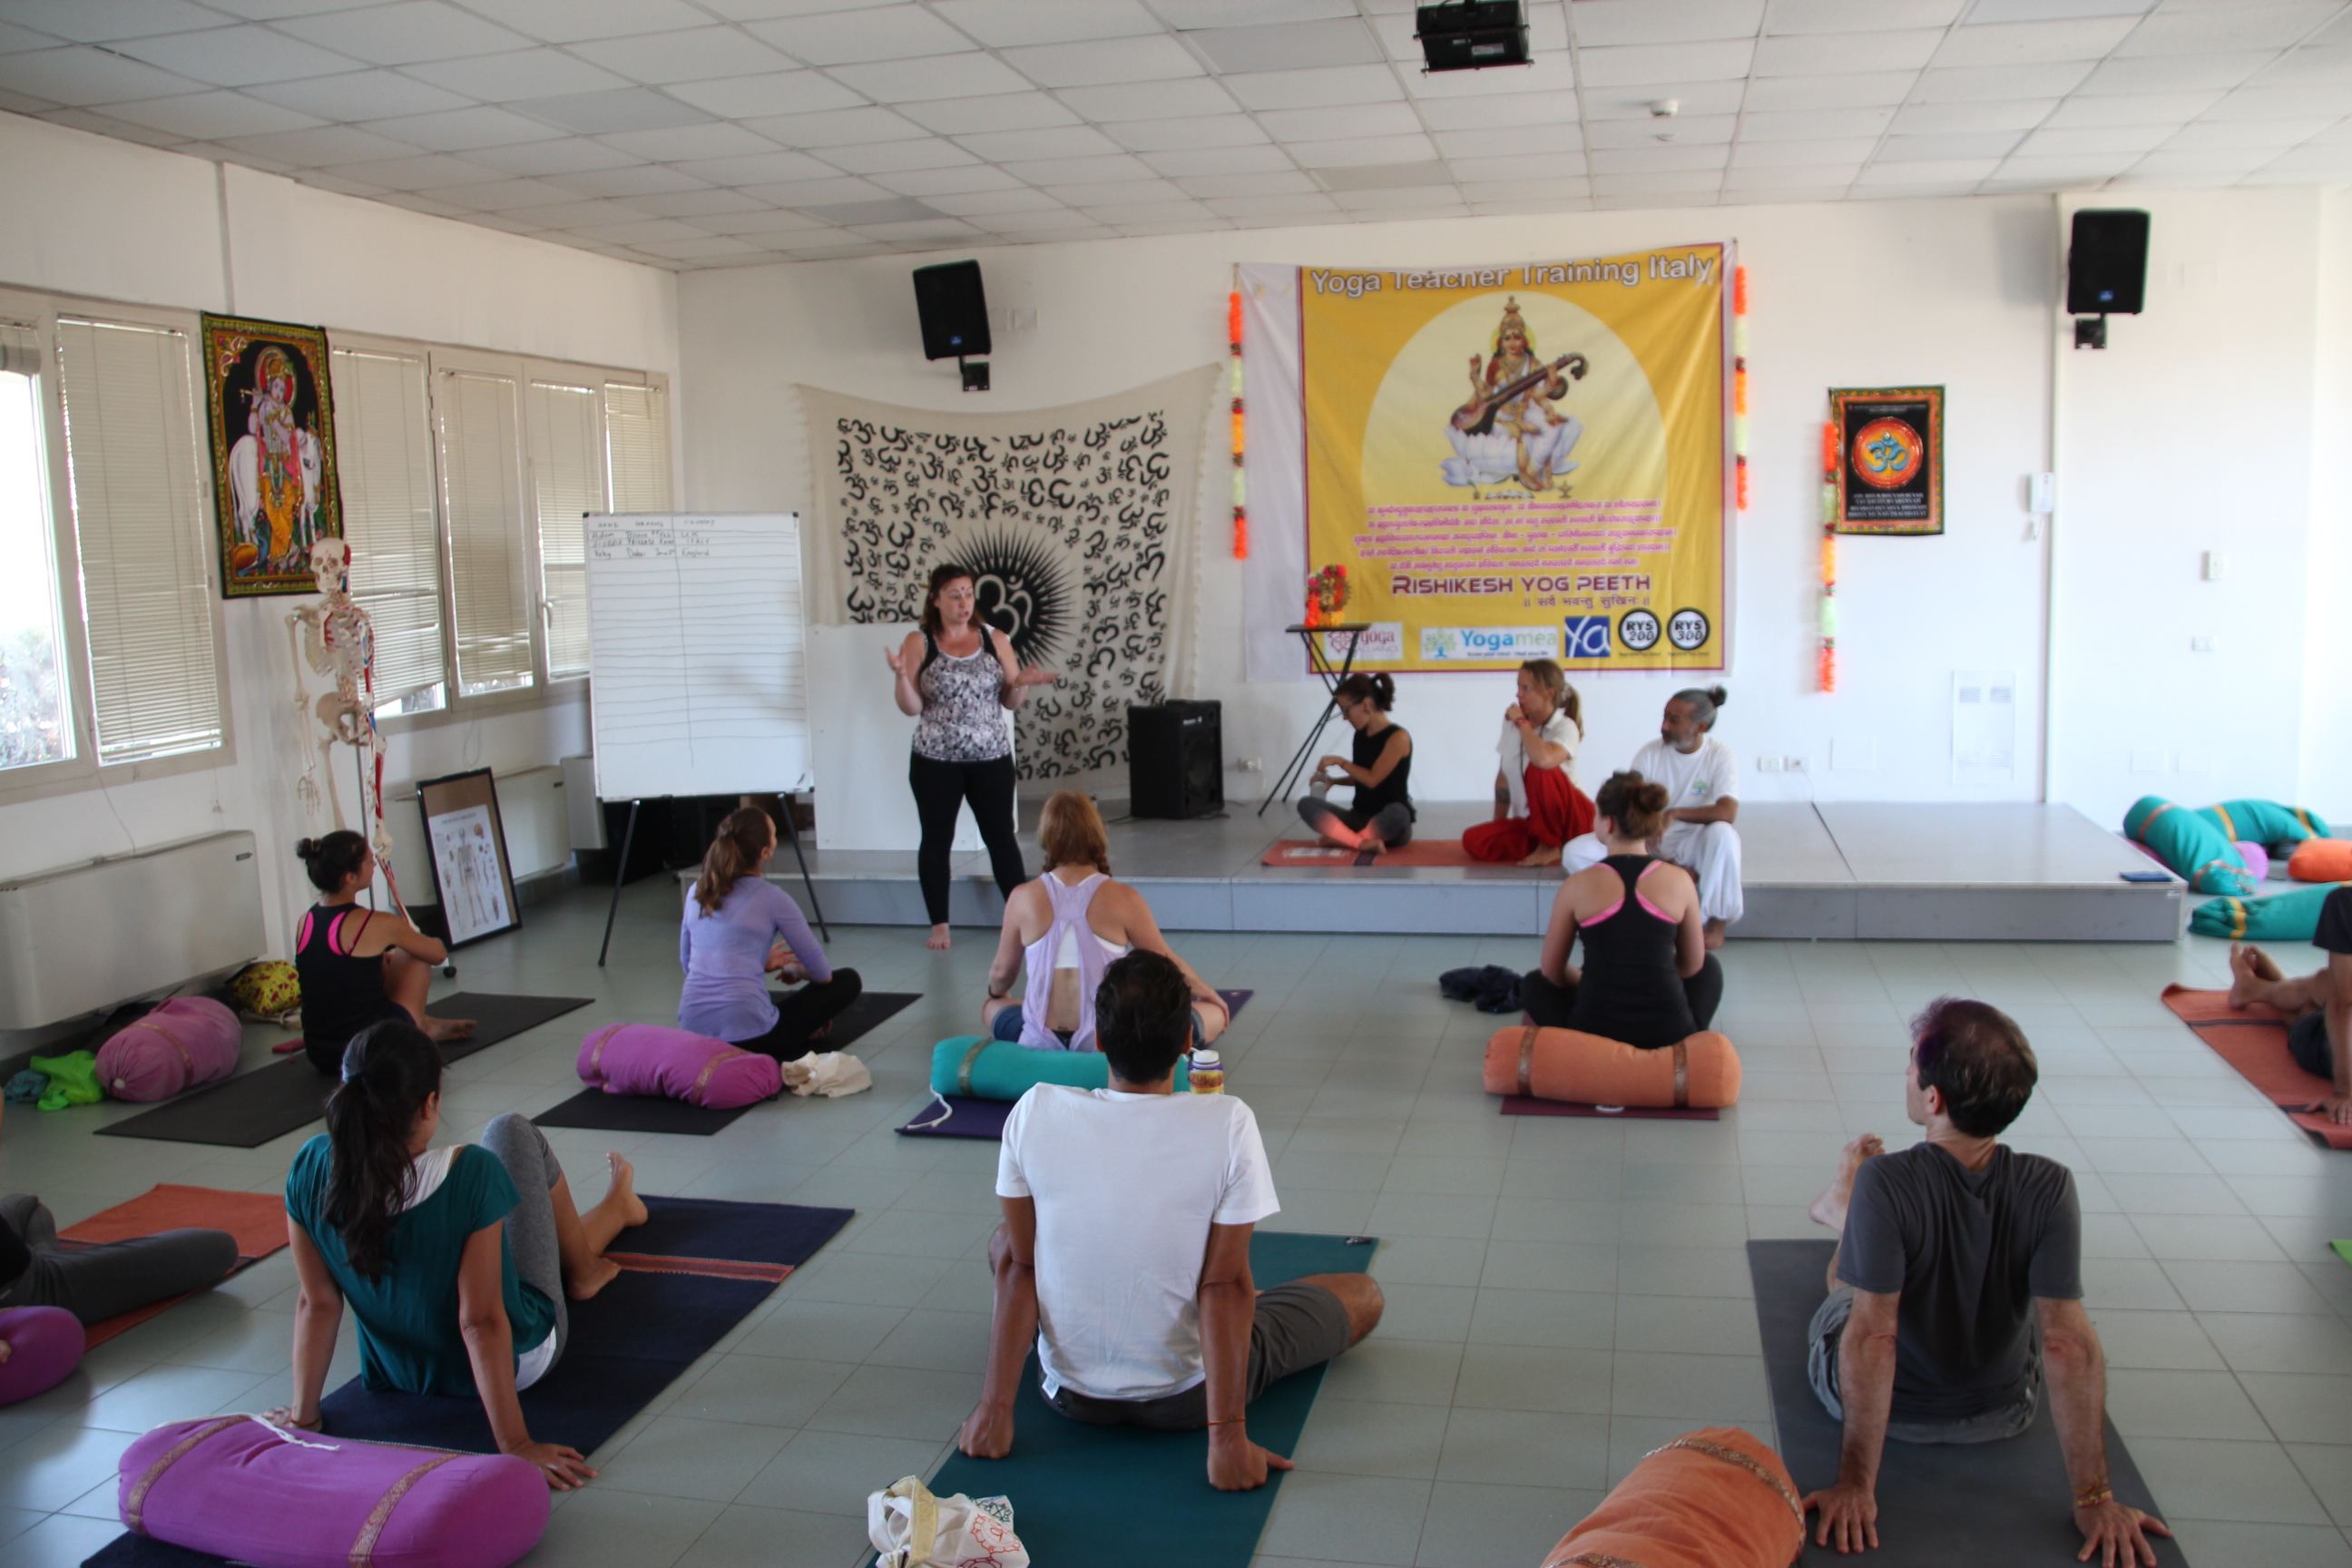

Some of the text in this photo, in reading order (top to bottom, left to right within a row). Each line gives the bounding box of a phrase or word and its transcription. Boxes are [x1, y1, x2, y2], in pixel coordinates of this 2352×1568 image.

[1311, 270, 1382, 299] Yoga
[1522, 259, 1640, 287] Training
[1649, 252, 1713, 283] Italy
[1392, 574, 1651, 594] RISHIKESH YOG PEETH
[1626, 620, 1653, 631] RYS
[1675, 620, 1702, 631] RYS
[1460, 629, 1557, 651] Yogamea
[1629, 632, 1654, 642] 200
[1677, 631, 1703, 641] 300
